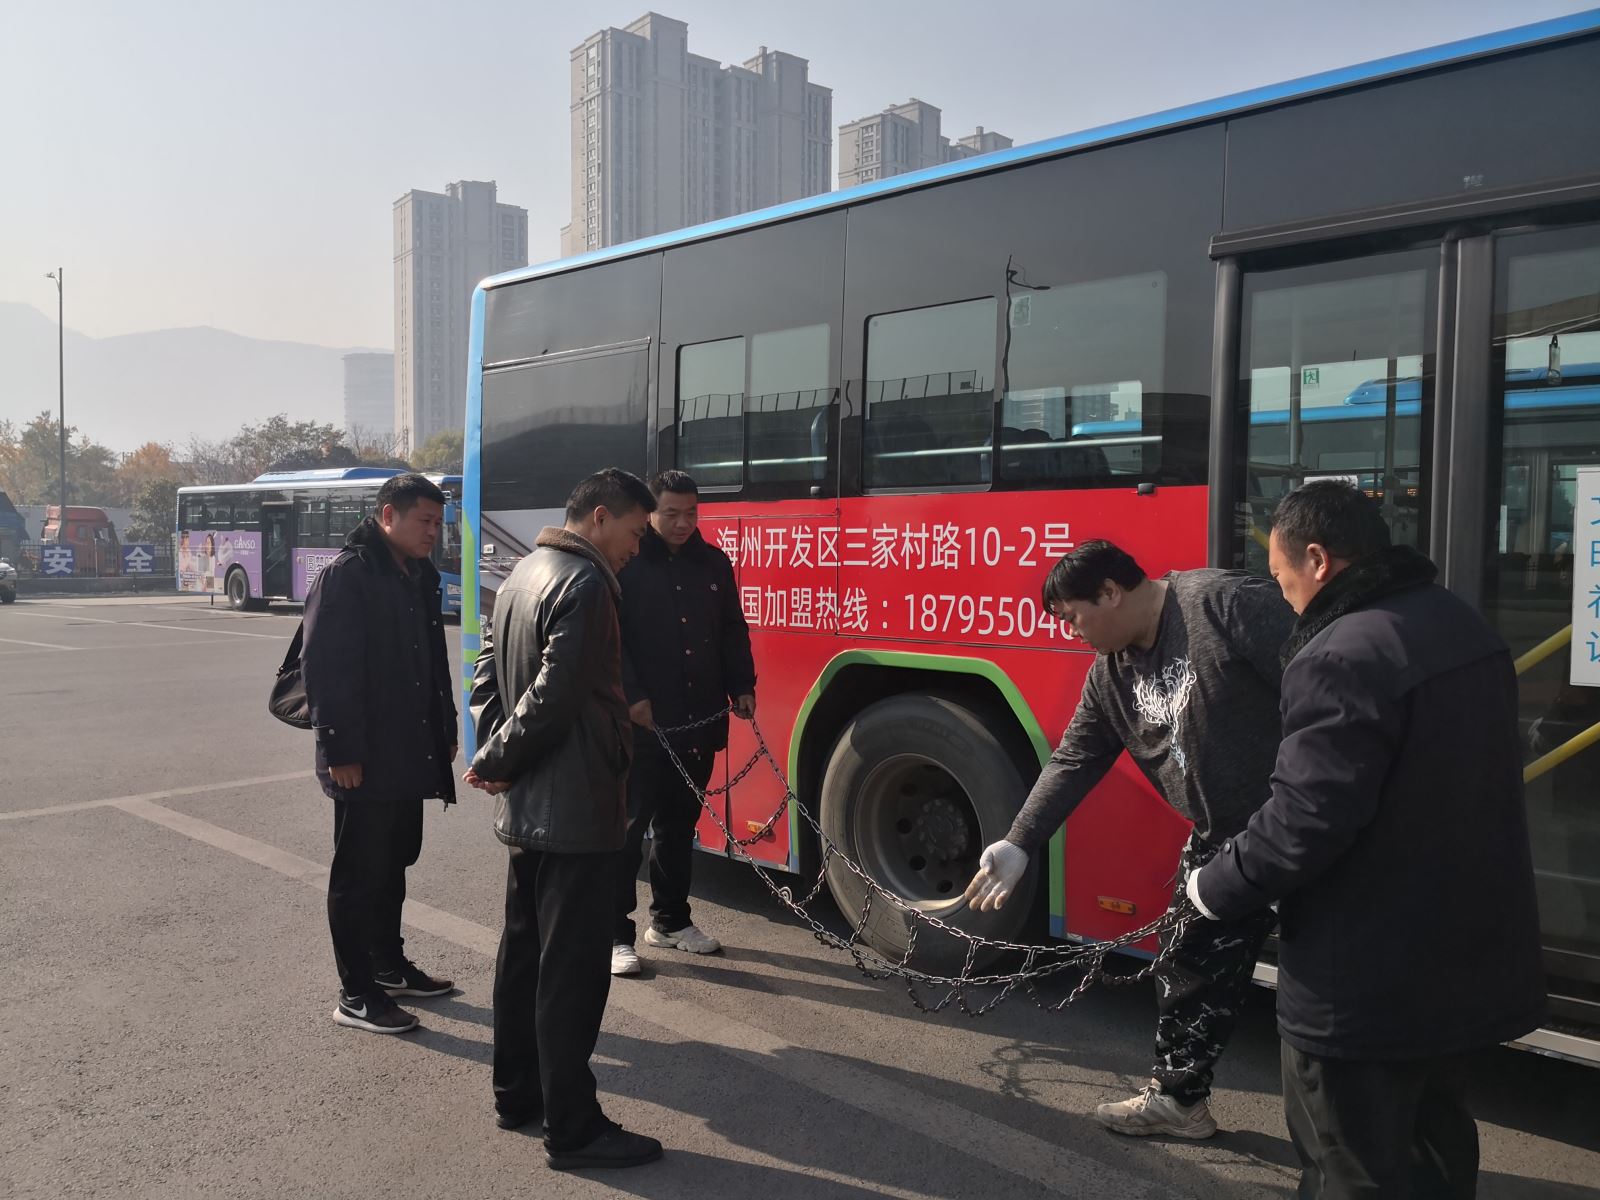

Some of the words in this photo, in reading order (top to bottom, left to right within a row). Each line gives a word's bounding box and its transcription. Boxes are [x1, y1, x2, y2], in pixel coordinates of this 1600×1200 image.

[124, 546, 153, 573] 全
[717, 521, 1074, 570] 海州开发区三家村路10-2号
[43, 546, 73, 575] 安
